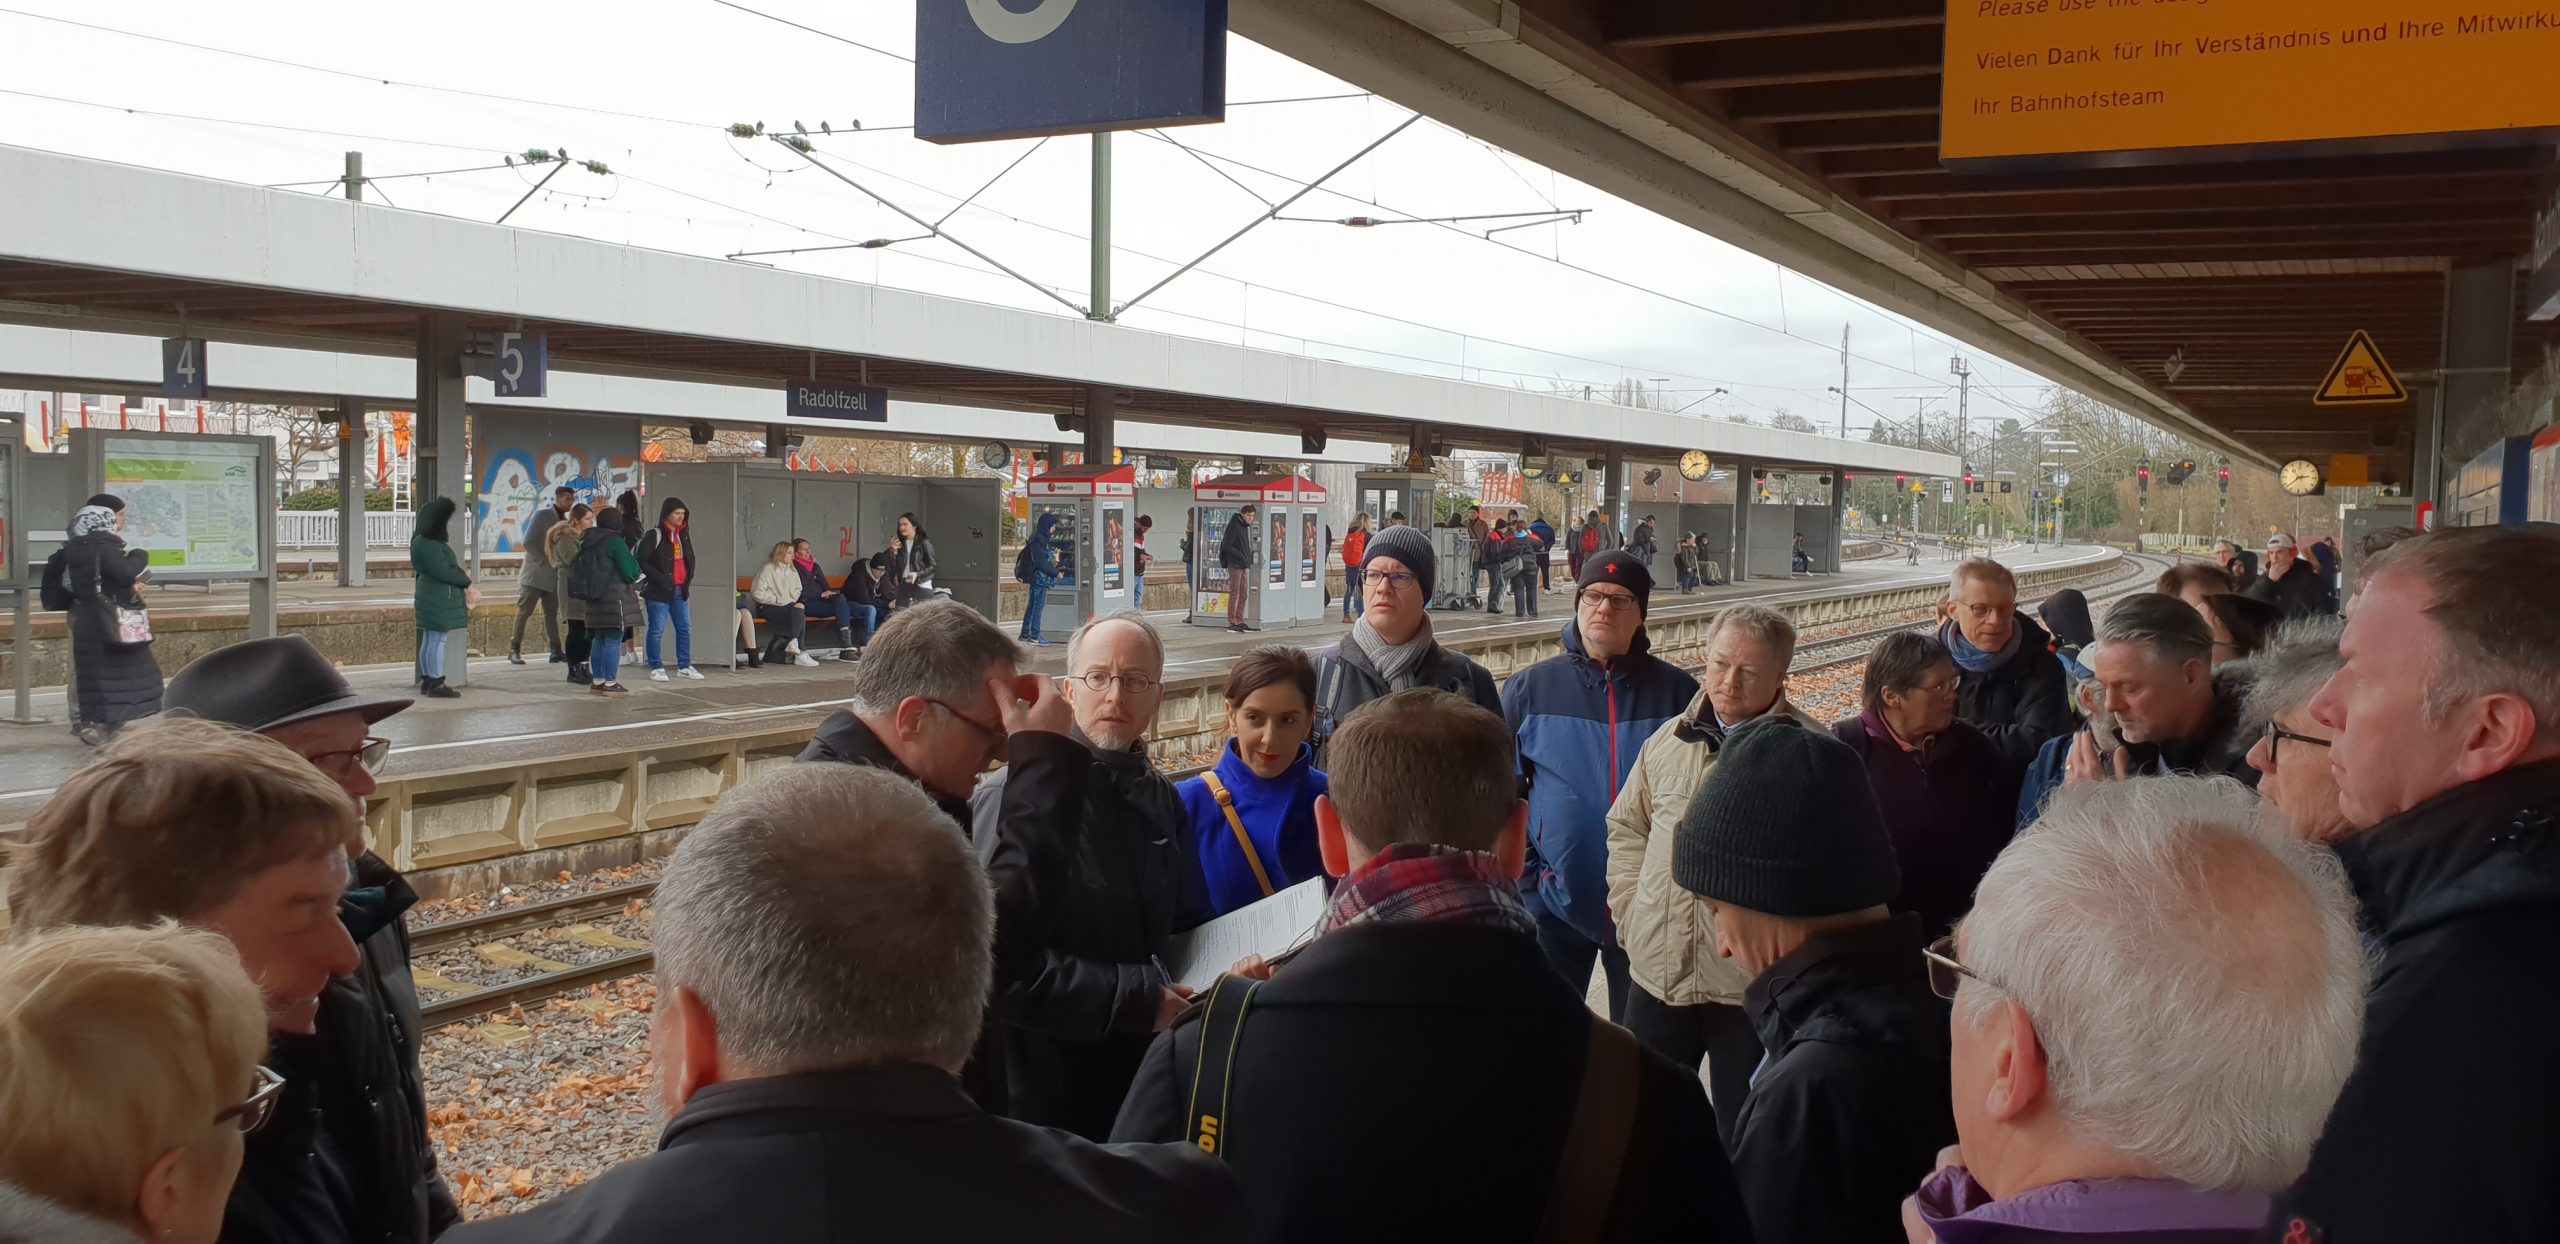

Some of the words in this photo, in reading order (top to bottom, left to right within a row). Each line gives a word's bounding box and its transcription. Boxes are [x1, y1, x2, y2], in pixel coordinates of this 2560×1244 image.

[1978, 0, 2049, 18] Please
[1976, 52, 2037, 69] Vielen
[2048, 46, 2100, 65] Dank
[2114, 43, 2143, 60] für
[2154, 40, 2183, 57] Ihr
[2196, 28, 2330, 54] Verständnis
[2341, 22, 2387, 44] und
[2399, 20, 2444, 40] Ihre
[1973, 98, 2000, 115] Ihr
[2010, 90, 2164, 113] Bahnhofsteam
[176, 340, 196, 384] 4
[501, 332, 524, 382] 5
[799, 387, 868, 411] Radolfzell
